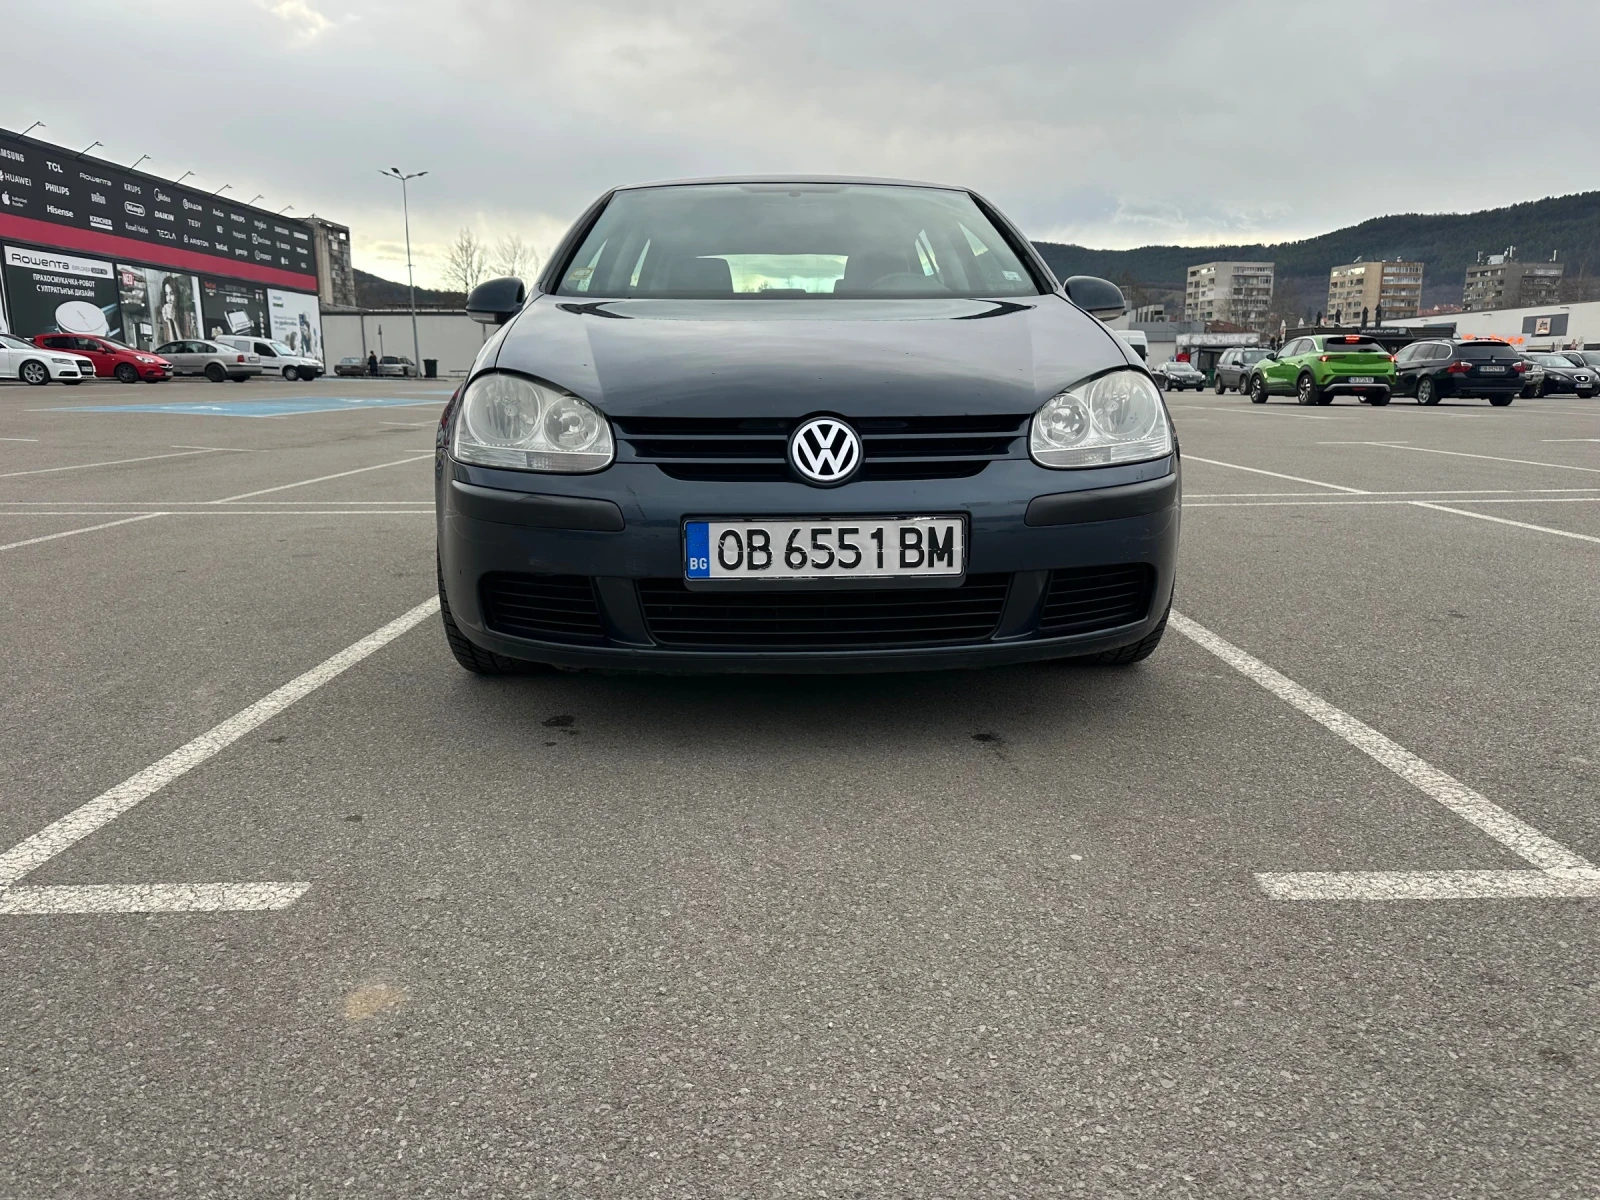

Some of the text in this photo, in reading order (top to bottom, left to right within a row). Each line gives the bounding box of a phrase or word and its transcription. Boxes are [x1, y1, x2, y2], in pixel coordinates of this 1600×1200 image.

[45, 161, 64, 174] TCL
[4, 172, 32, 187] HUAWEI
[44, 182, 70, 196] PHILIPS
[123, 182, 142, 195] KRUPS
[46, 204, 74, 218] Hisense
[154, 210, 175, 222] DAIKIN
[187, 218, 202, 229] TESY
[190, 237, 209, 247] ARISTON
[11, 253, 70, 270] Rowenta
[32, 273, 95, 288] ПРАХОСМУКАЧКА-РОБОТ
[717, 526, 954, 571] OB 6551 BM
[689, 557, 708, 570] BG
